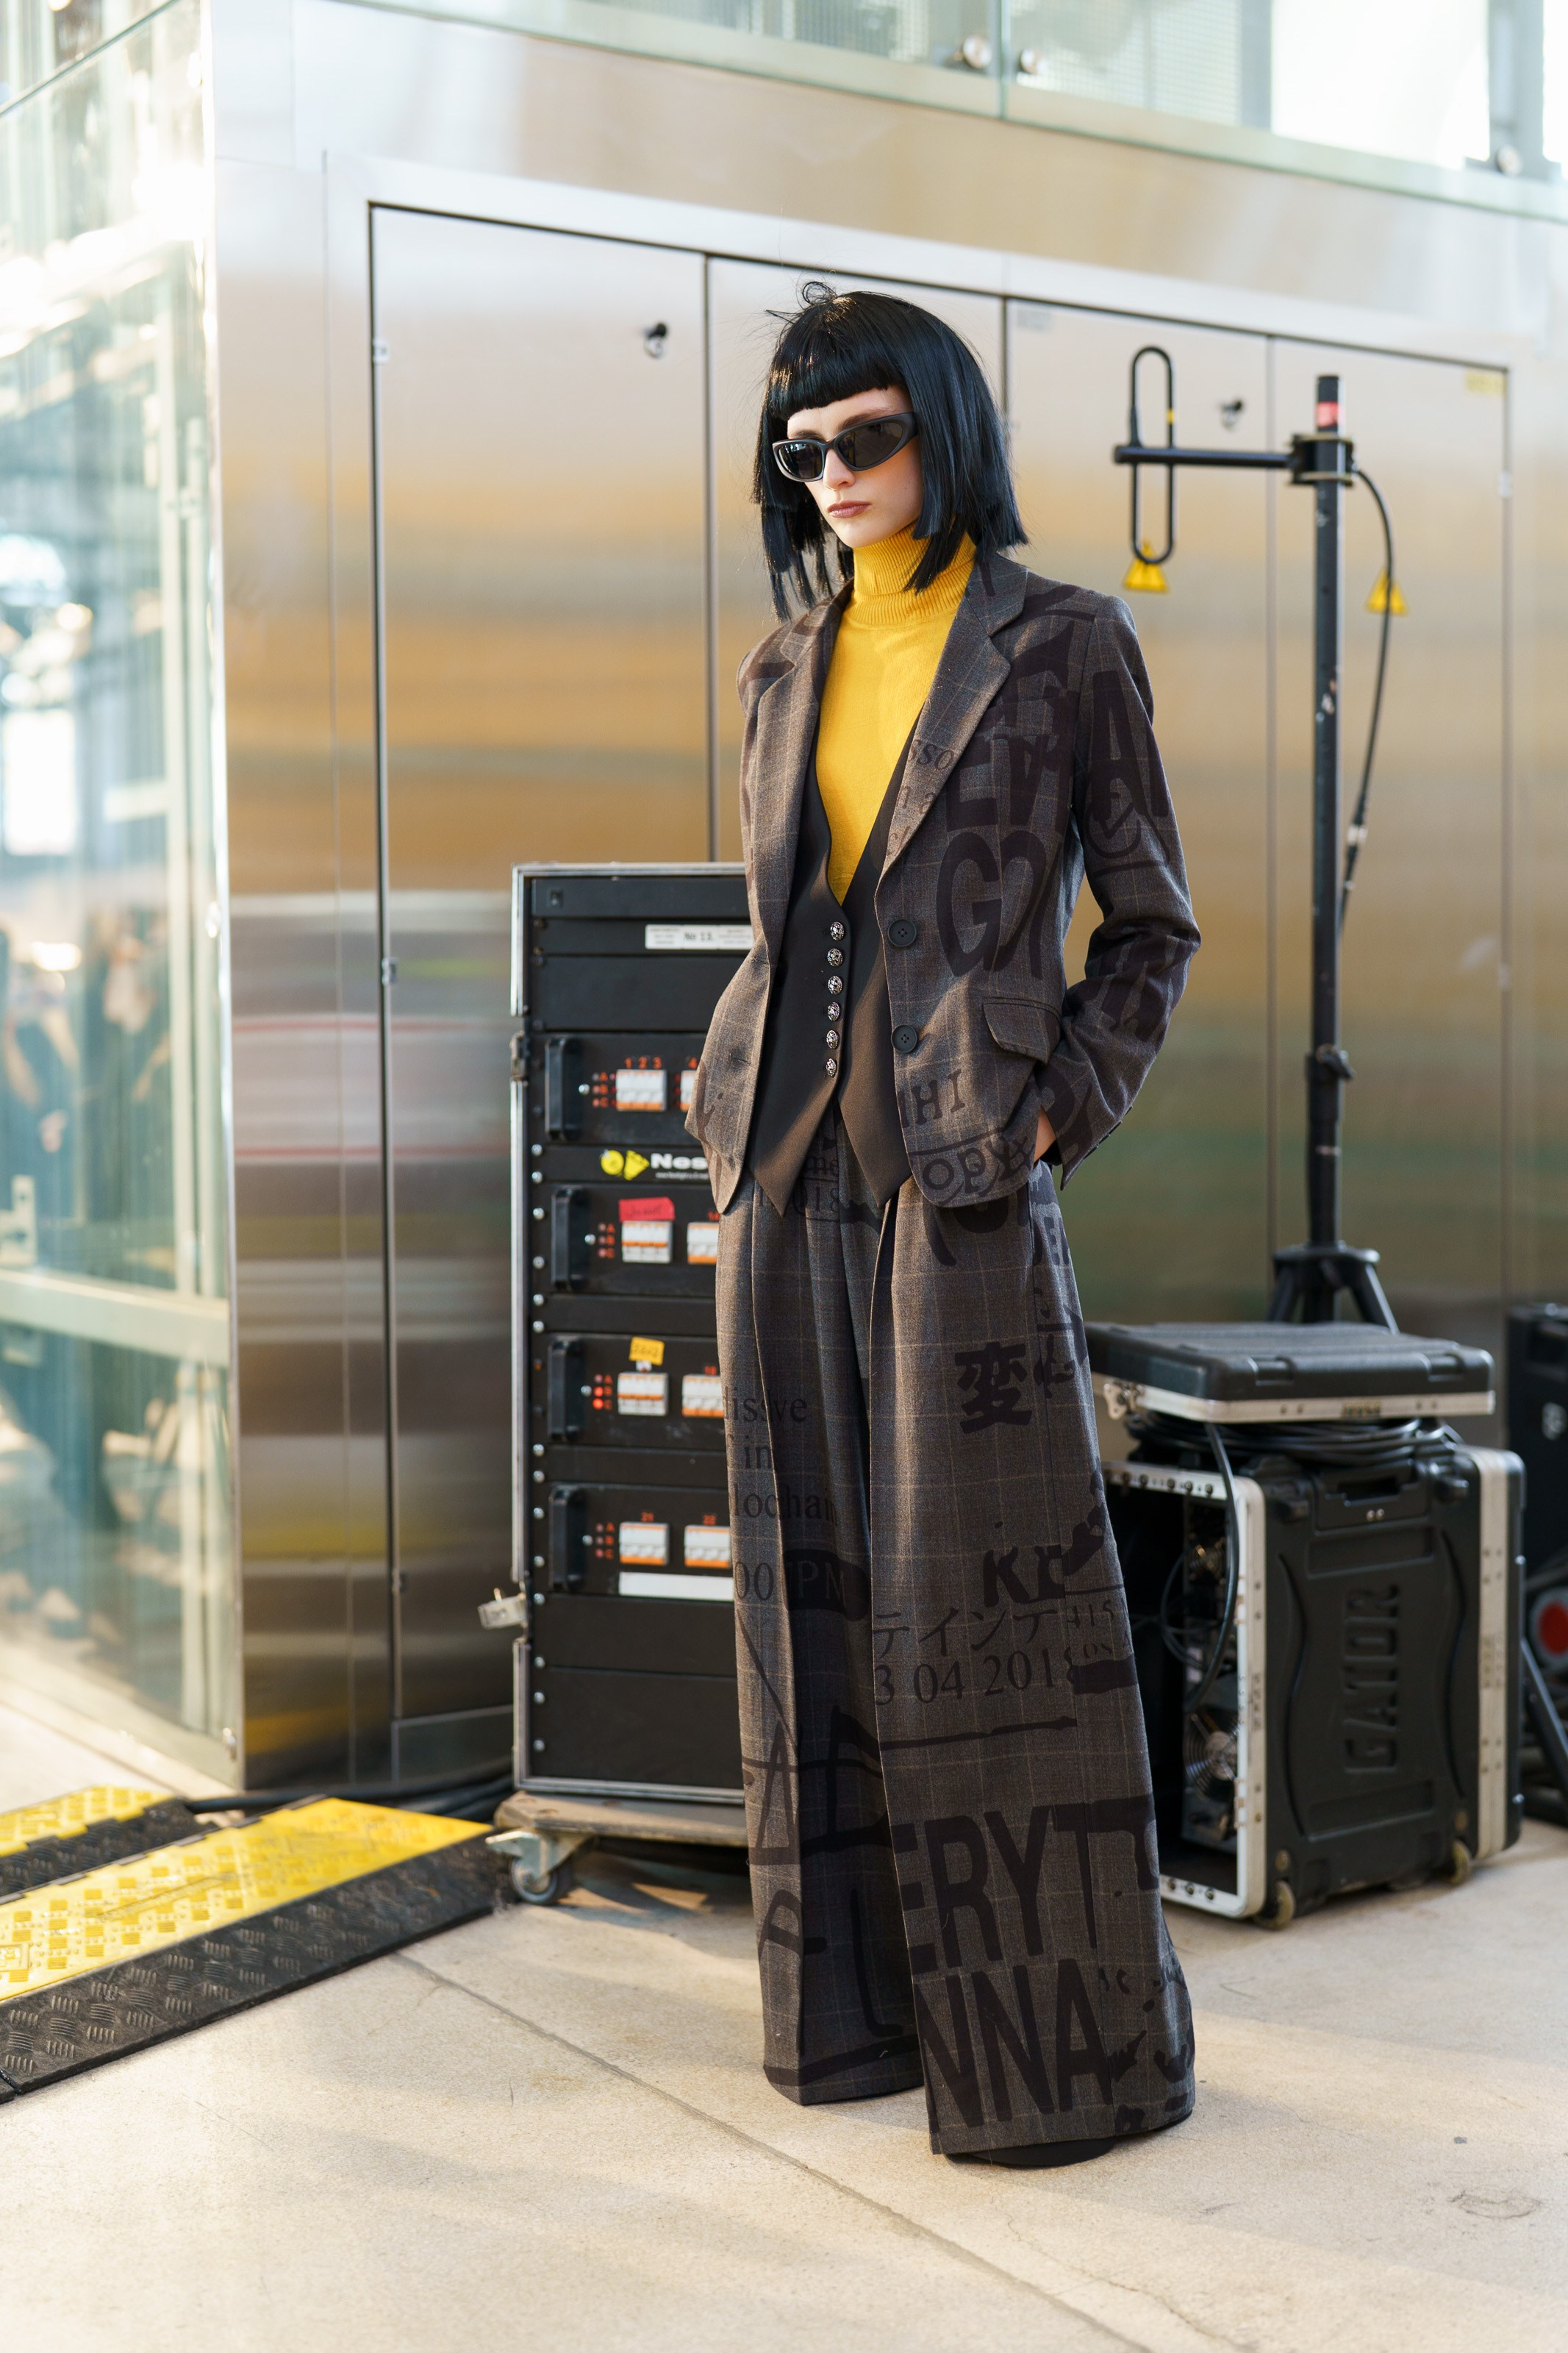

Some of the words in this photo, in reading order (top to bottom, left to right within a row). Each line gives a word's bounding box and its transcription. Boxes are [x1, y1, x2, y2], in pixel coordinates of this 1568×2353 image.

[625, 1056, 632, 1070] 1
[638, 1056, 648, 1070] 2
[652, 1056, 662, 1070] 3
[687, 1057, 698, 1070] 4
[599, 1071, 609, 1082] A
[606, 1521, 615, 1533] A
[913, 1660, 965, 1704] 04
[1343, 1583, 1400, 1773] GATOR
